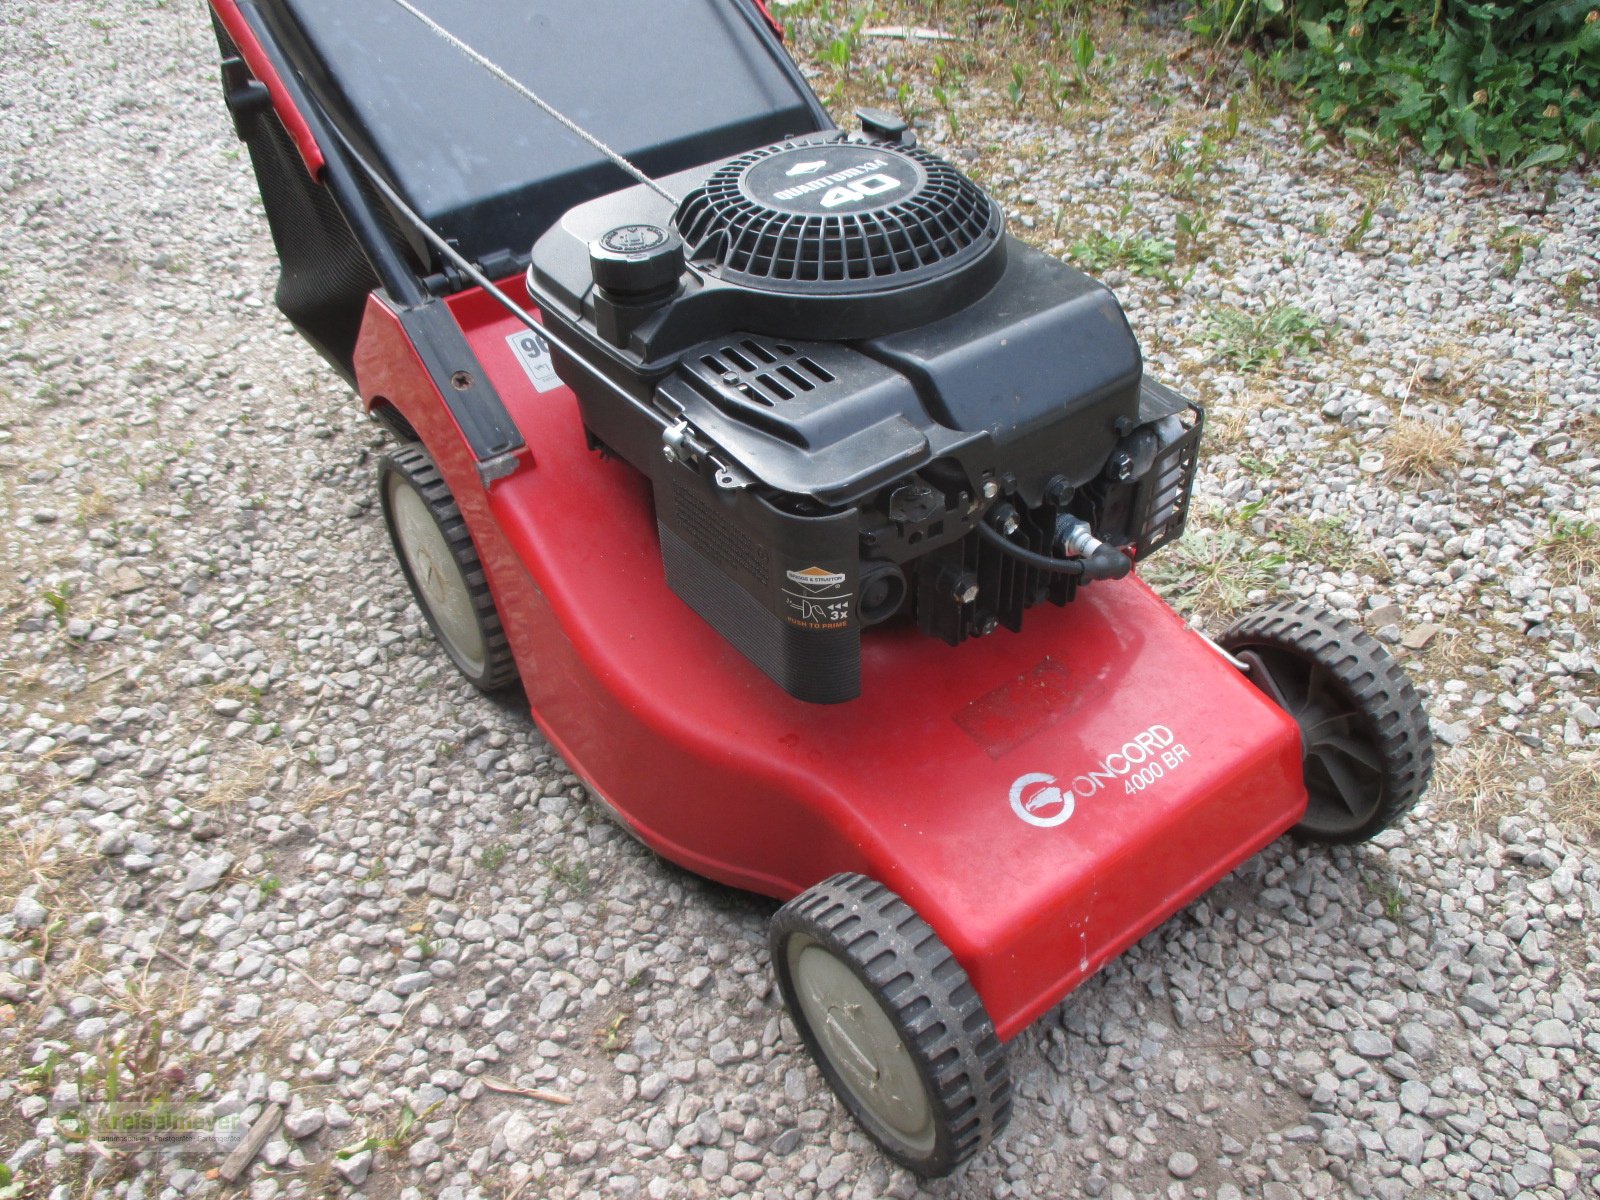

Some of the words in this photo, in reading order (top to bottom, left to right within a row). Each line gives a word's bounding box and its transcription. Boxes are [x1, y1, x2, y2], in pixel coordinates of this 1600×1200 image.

[820, 173, 901, 208] 40
[788, 572, 809, 582] BRIGGS
[787, 616, 807, 628] PUSH
[822, 620, 849, 629] PRIME
[1124, 761, 1164, 796] 4000
[1160, 743, 1192, 770] BR
